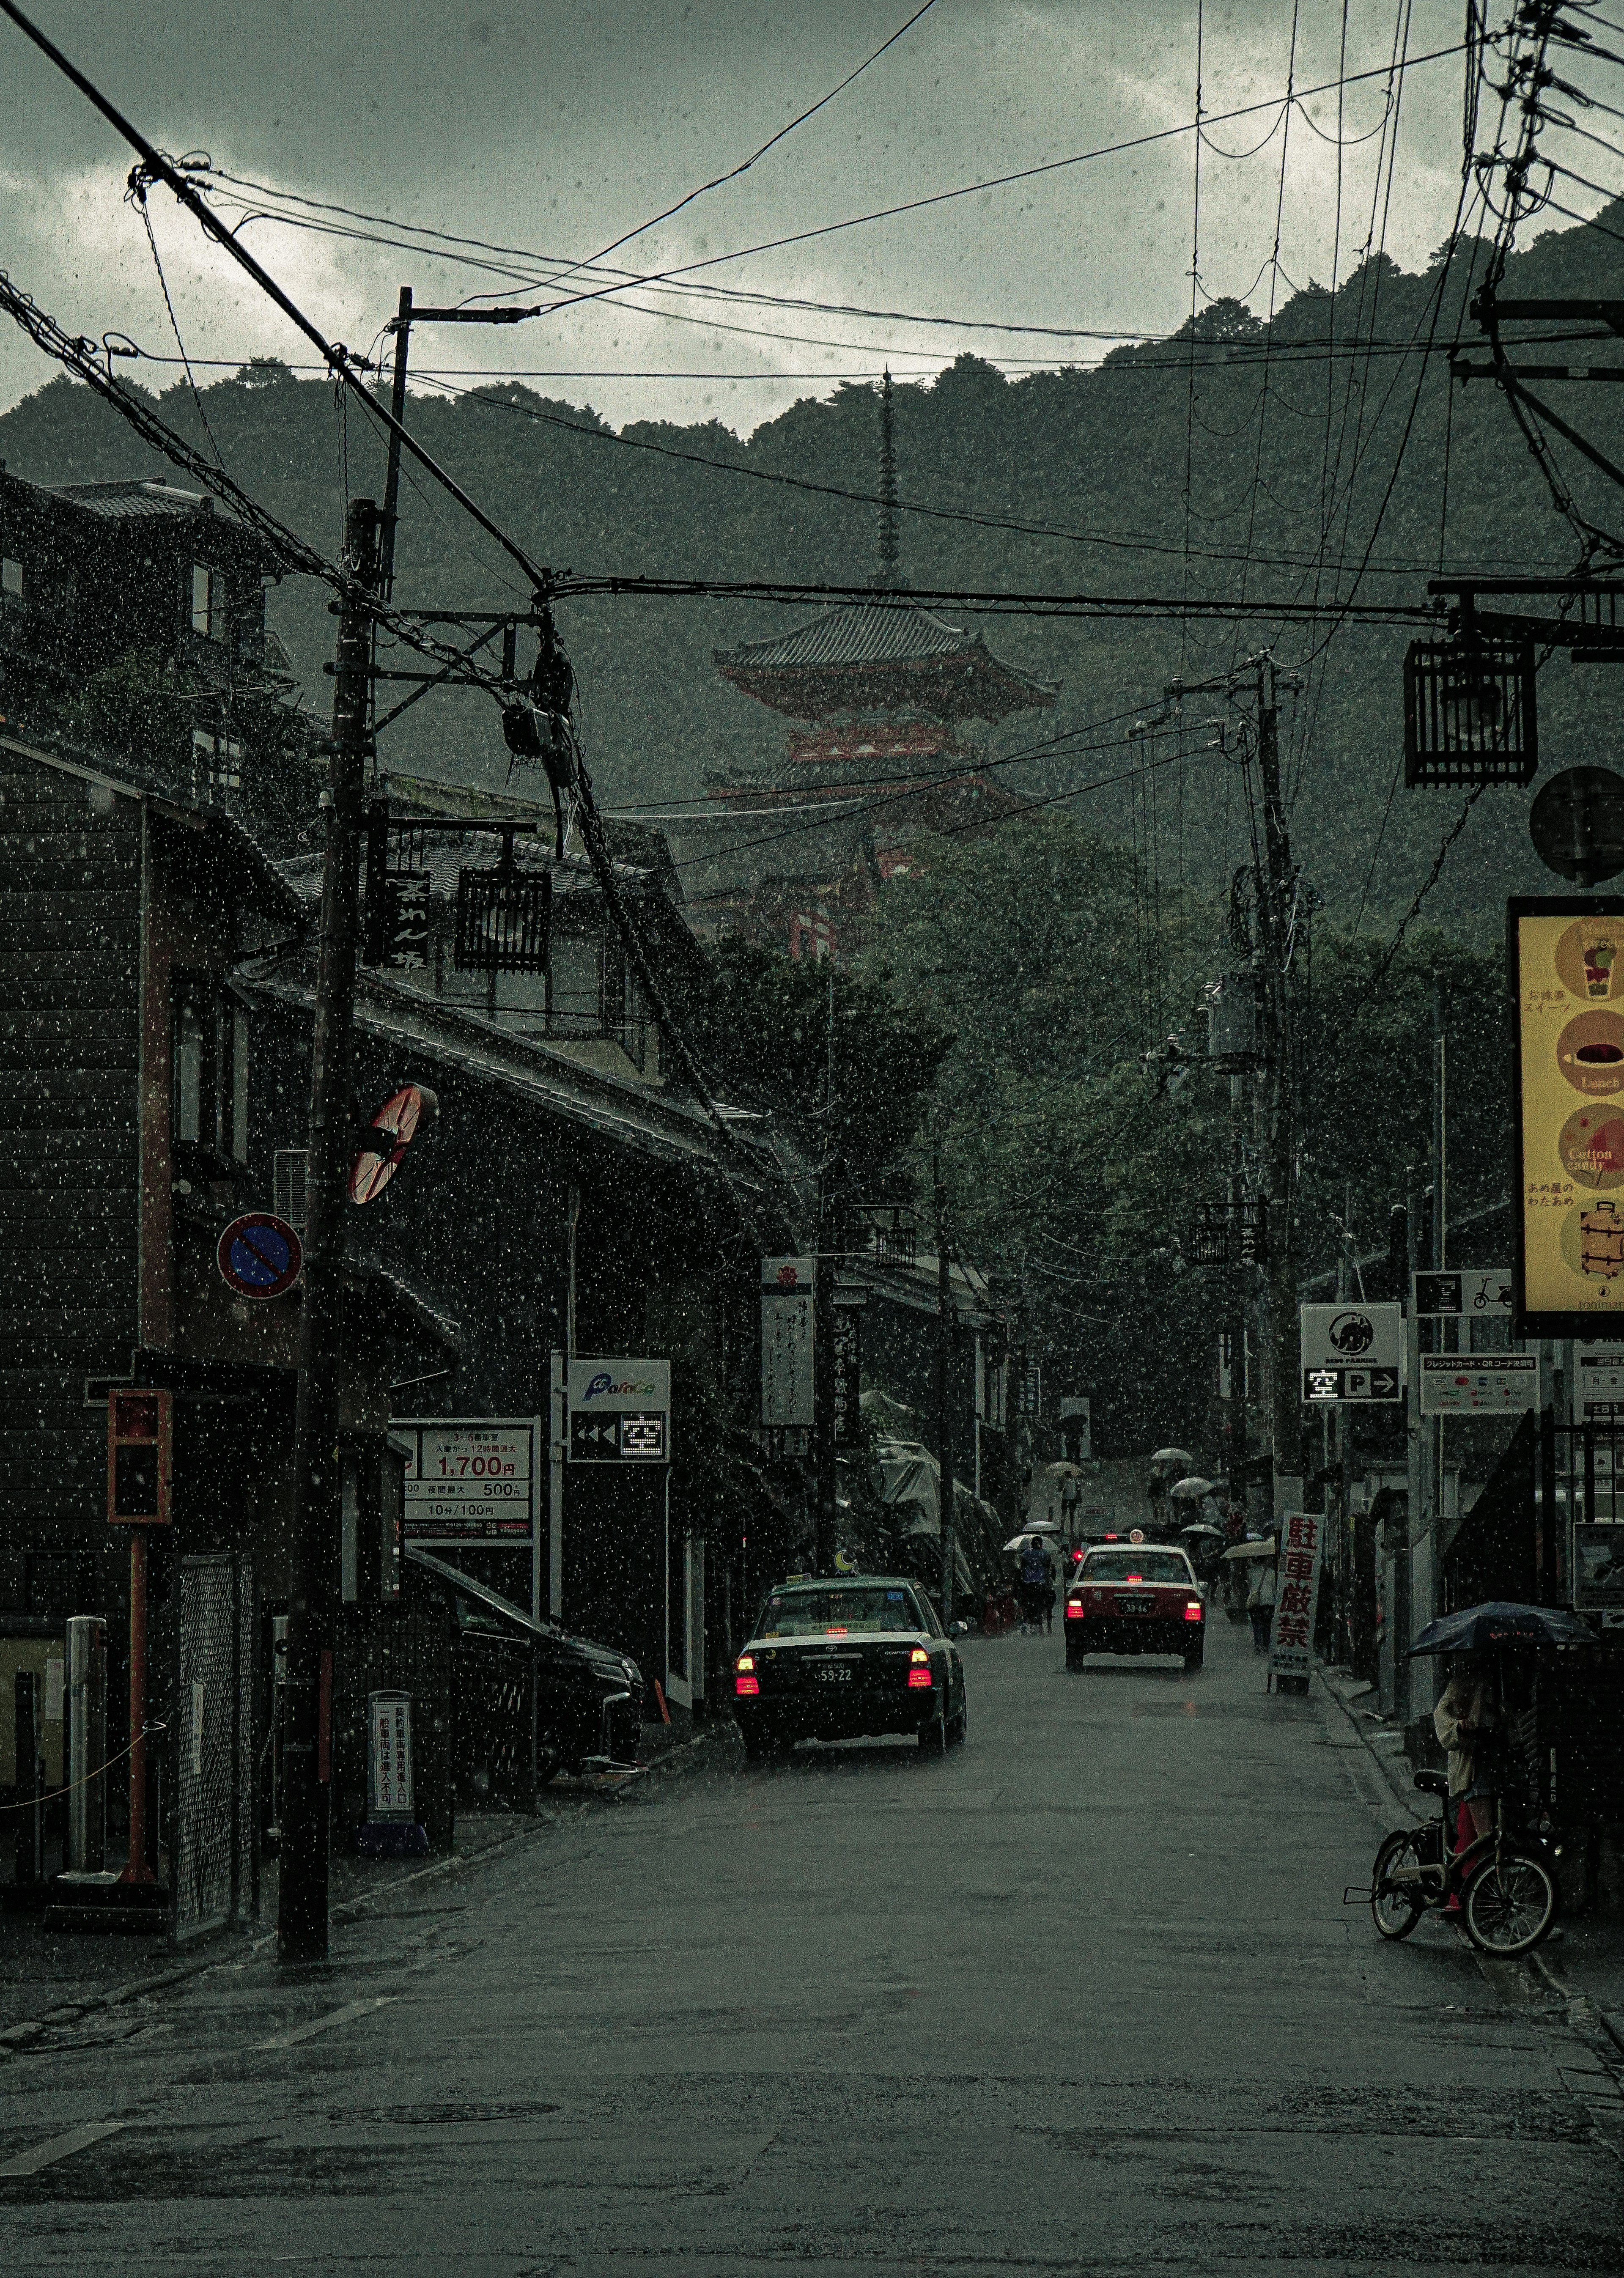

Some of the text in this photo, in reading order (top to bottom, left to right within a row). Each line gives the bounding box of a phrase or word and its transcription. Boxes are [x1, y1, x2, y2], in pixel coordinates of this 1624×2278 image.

[391, 882, 428, 969] 茶わん坂
[1523, 1004, 1570, 1013] スイーツ
[1581, 1077, 1620, 1088] Lunch
[1569, 1147, 1613, 1160] Cotton
[1528, 1183, 1574, 1194] あめ屋の
[1528, 1196, 1574, 1207] わたあめ
[1309, 1369, 1338, 1398] 空
[623, 1416, 661, 1453] 空
[439, 1456, 515, 1476] 1,700円
[428, 1485, 466, 1494] 夜間最大
[429, 1505, 494, 1515] 10分/100円
[1277, 1516, 1319, 1649] 駐車厳禁
[821, 1669, 852, 1682] 59-22
[379, 1710, 392, 1804] 一般車両は進入不可
